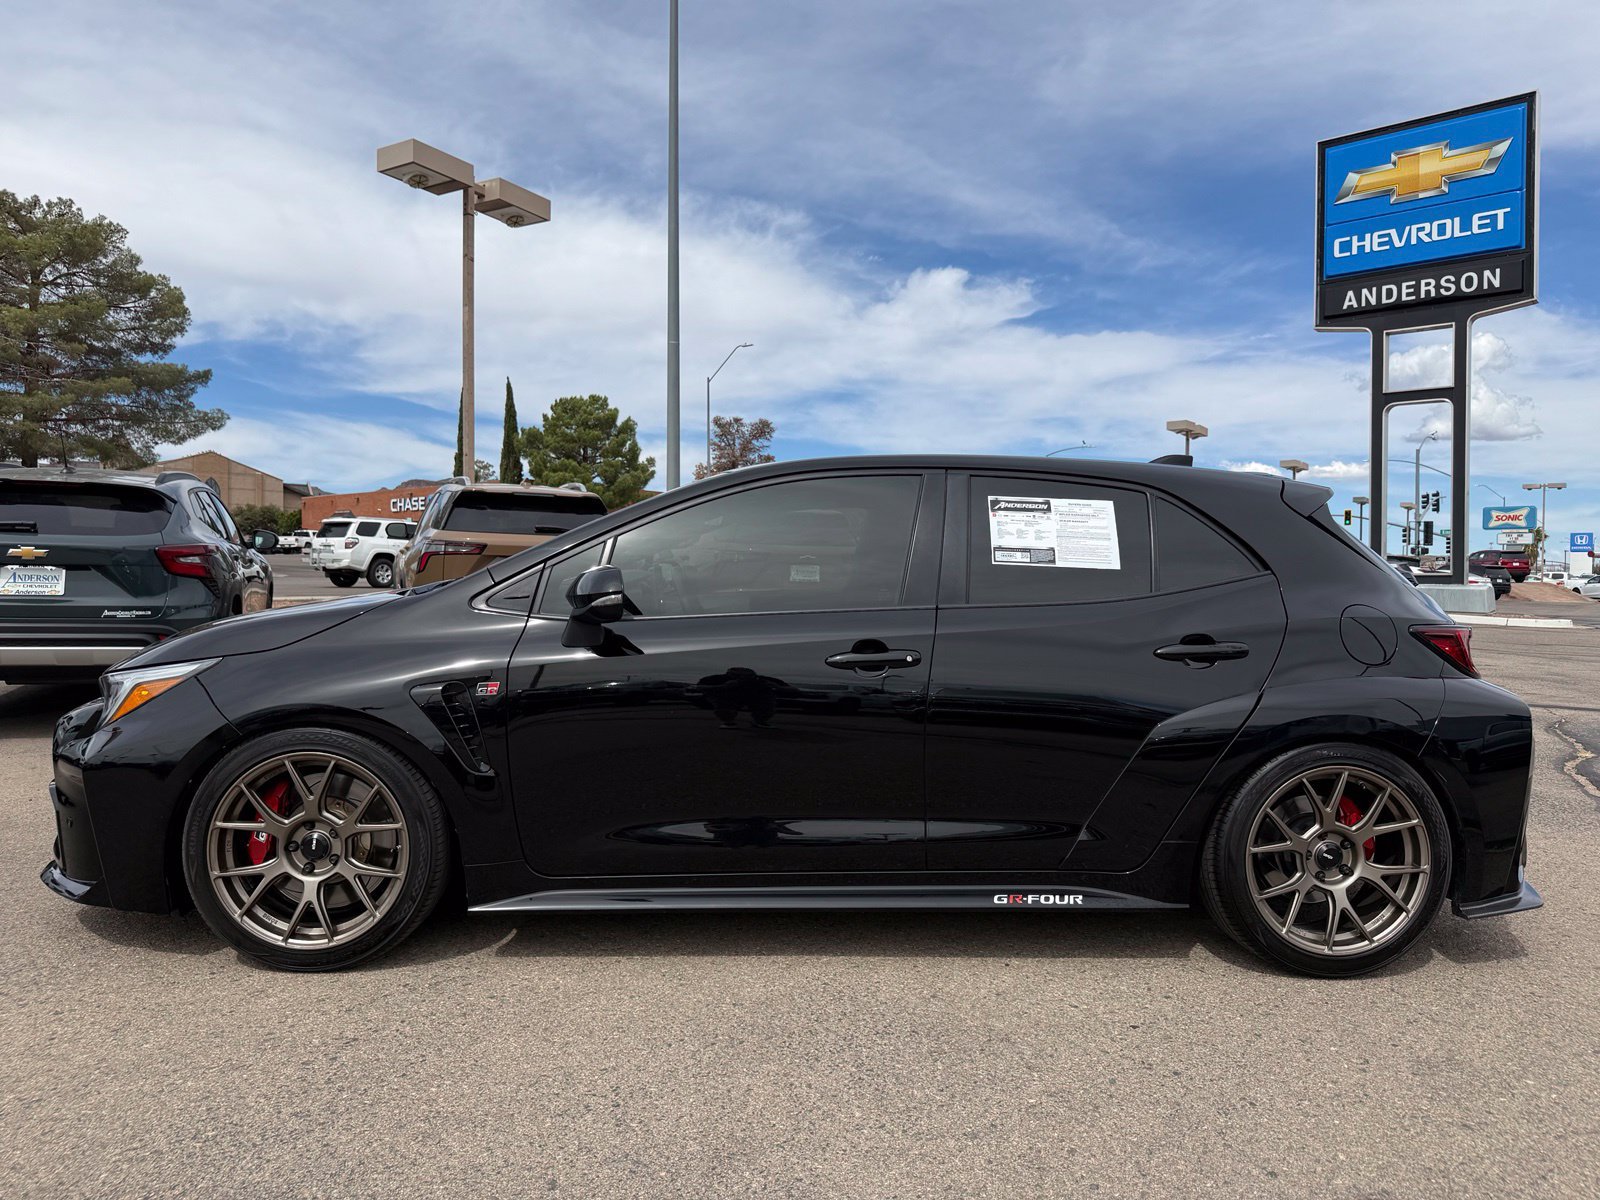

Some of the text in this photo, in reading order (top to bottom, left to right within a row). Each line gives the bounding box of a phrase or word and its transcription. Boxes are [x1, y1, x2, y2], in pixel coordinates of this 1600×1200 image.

[1333, 207, 1511, 258] CHEVROLET
[1342, 268, 1501, 310] ANDERSON
[390, 496, 426, 512] CHASE
[993, 501, 1049, 510] ANDERSON
[1494, 514, 1524, 522] SONIC
[1, 571, 60, 588] ANDERSON
[477, 687, 498, 695] GR
[993, 894, 1084, 905] GR-FOUR
